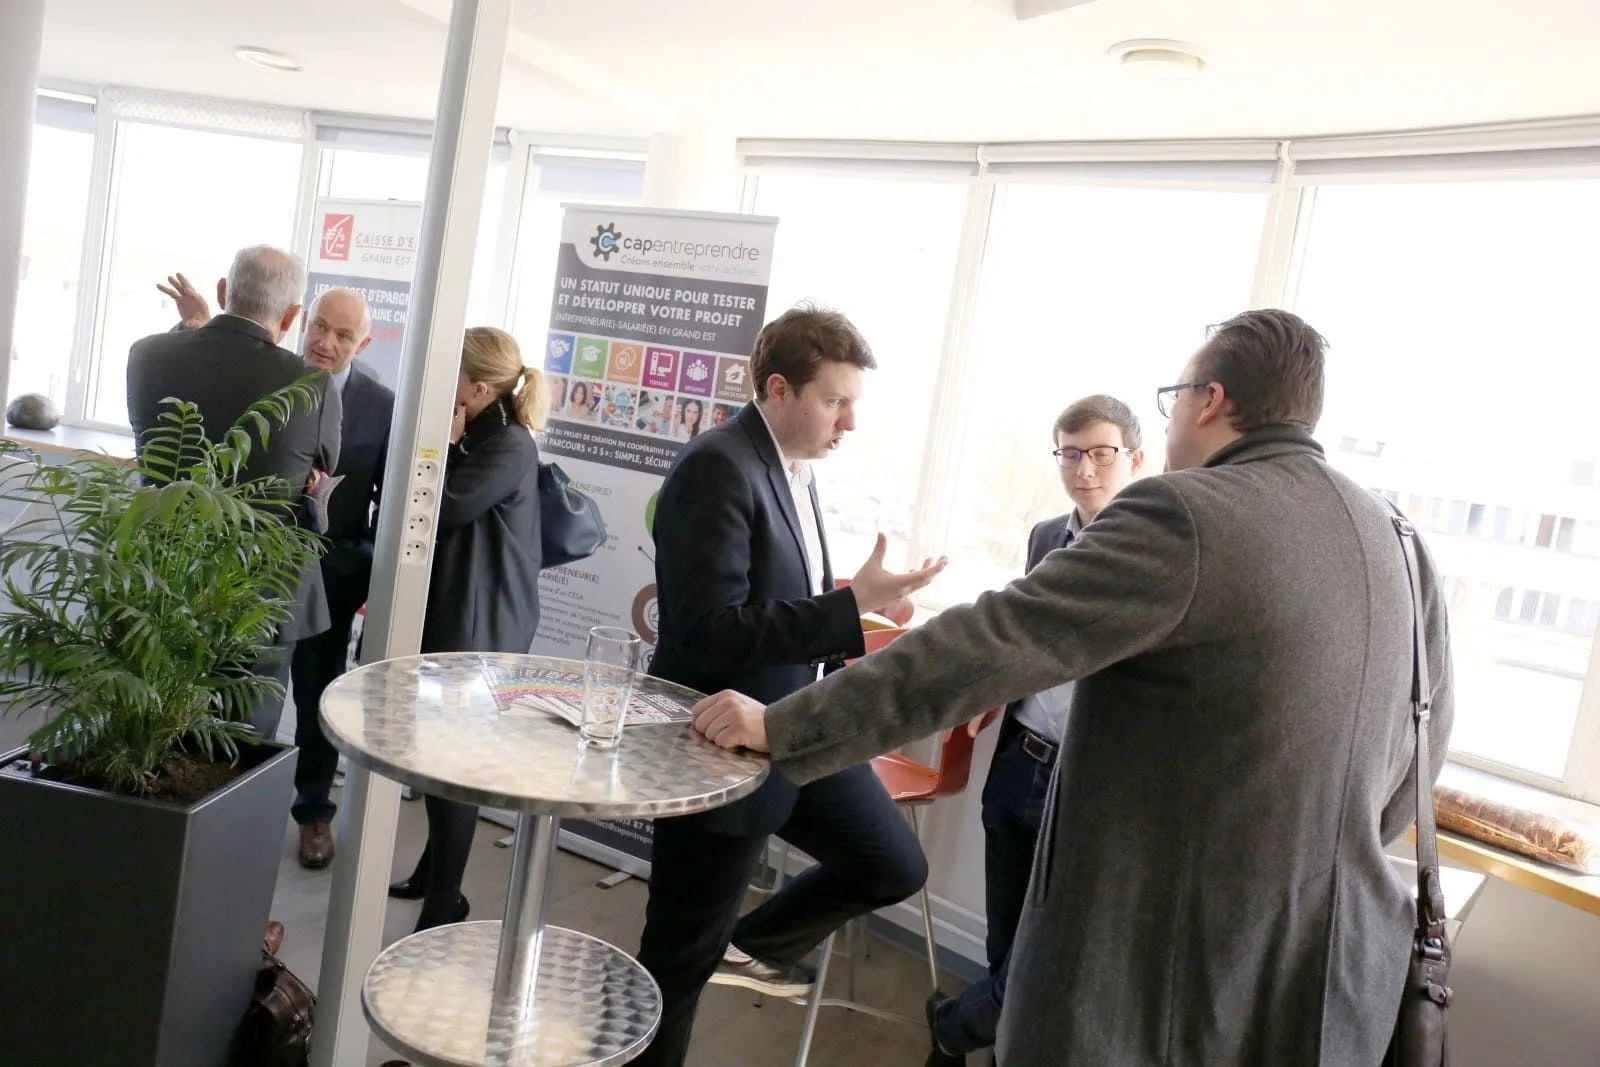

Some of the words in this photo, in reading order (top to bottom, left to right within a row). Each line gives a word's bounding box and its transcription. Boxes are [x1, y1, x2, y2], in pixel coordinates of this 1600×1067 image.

[356, 232, 394, 247] CAISSE
[623, 237, 760, 261] capentreprendre
[362, 253, 393, 264] GRAND
[395, 255, 411, 265] EST
[652, 258, 696, 272] ensemble
[560, 276, 577, 290] UN
[580, 279, 621, 295] STATUT
[623, 284, 672, 301] UNIQUE
[674, 289, 710, 305] POUR
[712, 293, 757, 311] TESTER
[558, 293, 570, 306] ET
[572, 293, 646, 316] DÉVELOPPER
[650, 304, 692, 321] VOTRE
[695, 310, 743, 328] PROJET
[658, 326, 671, 336] EN
[672, 327, 701, 340] GRAND
[702, 331, 718, 342] EST
[549, 438, 586, 453] PARCOURS
[614, 450, 642, 465] SIMPLE,
[644, 453, 672, 470] SÉCURI
[563, 430, 582, 440] PROJET
[583, 433, 591, 442] DE
[591, 433, 617, 446] CRÉATION
[626, 440, 665, 456] COOPÉRATIVE
